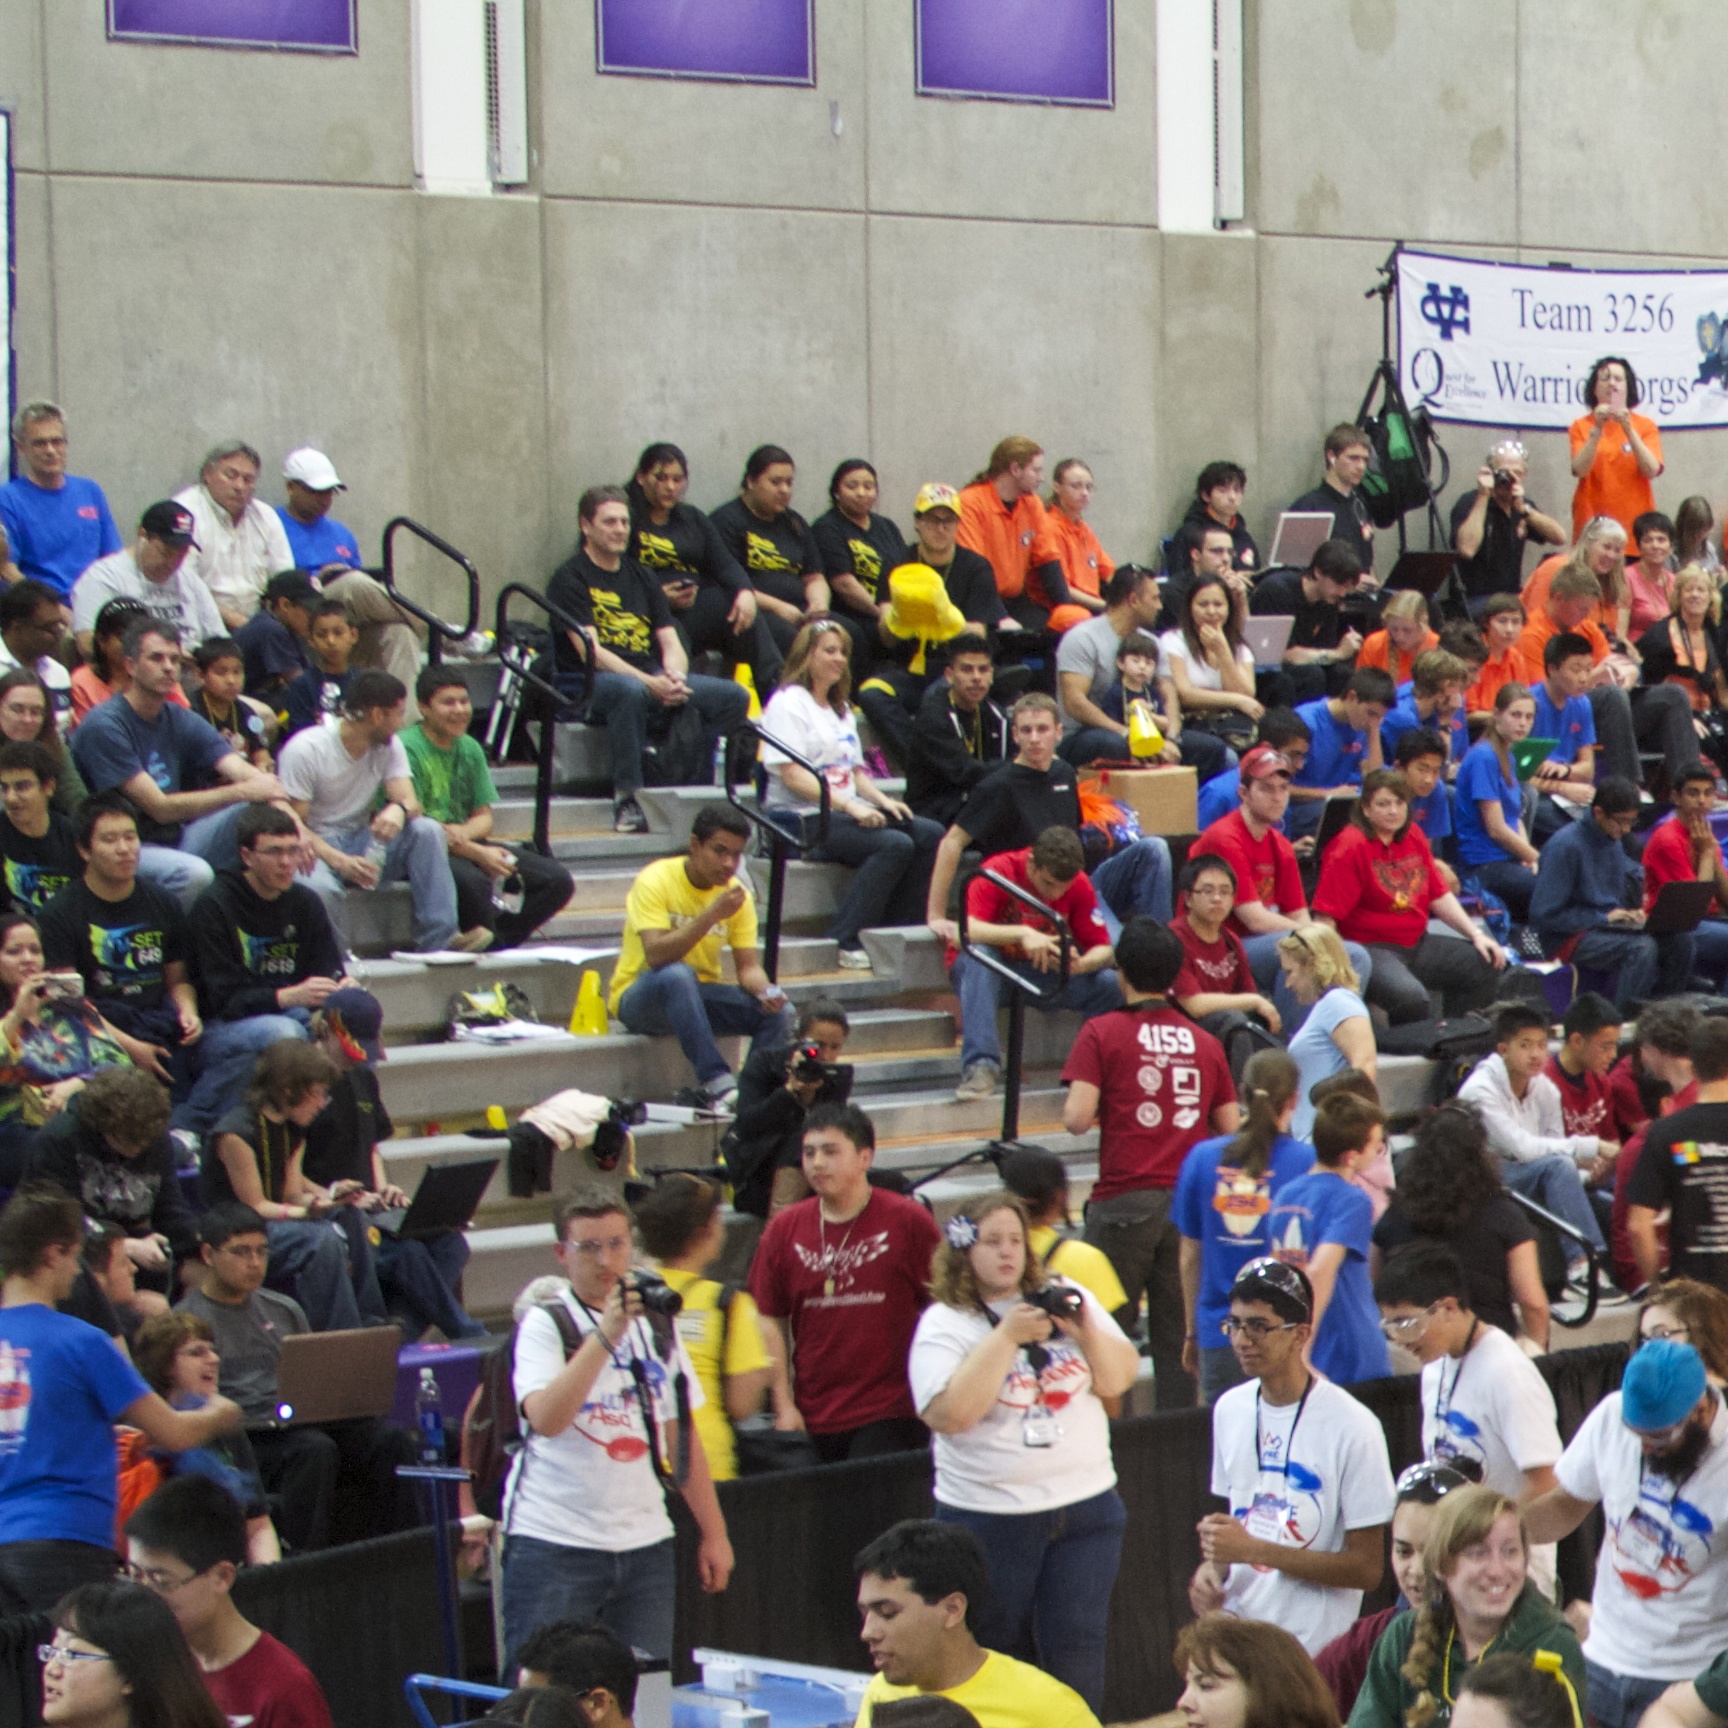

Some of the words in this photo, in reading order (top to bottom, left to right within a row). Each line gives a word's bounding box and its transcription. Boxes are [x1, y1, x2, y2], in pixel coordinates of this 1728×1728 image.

[1512, 289, 1593, 332] Team
[1603, 293, 1675, 333] 3256
[1137, 1023, 1196, 1054] 4159
